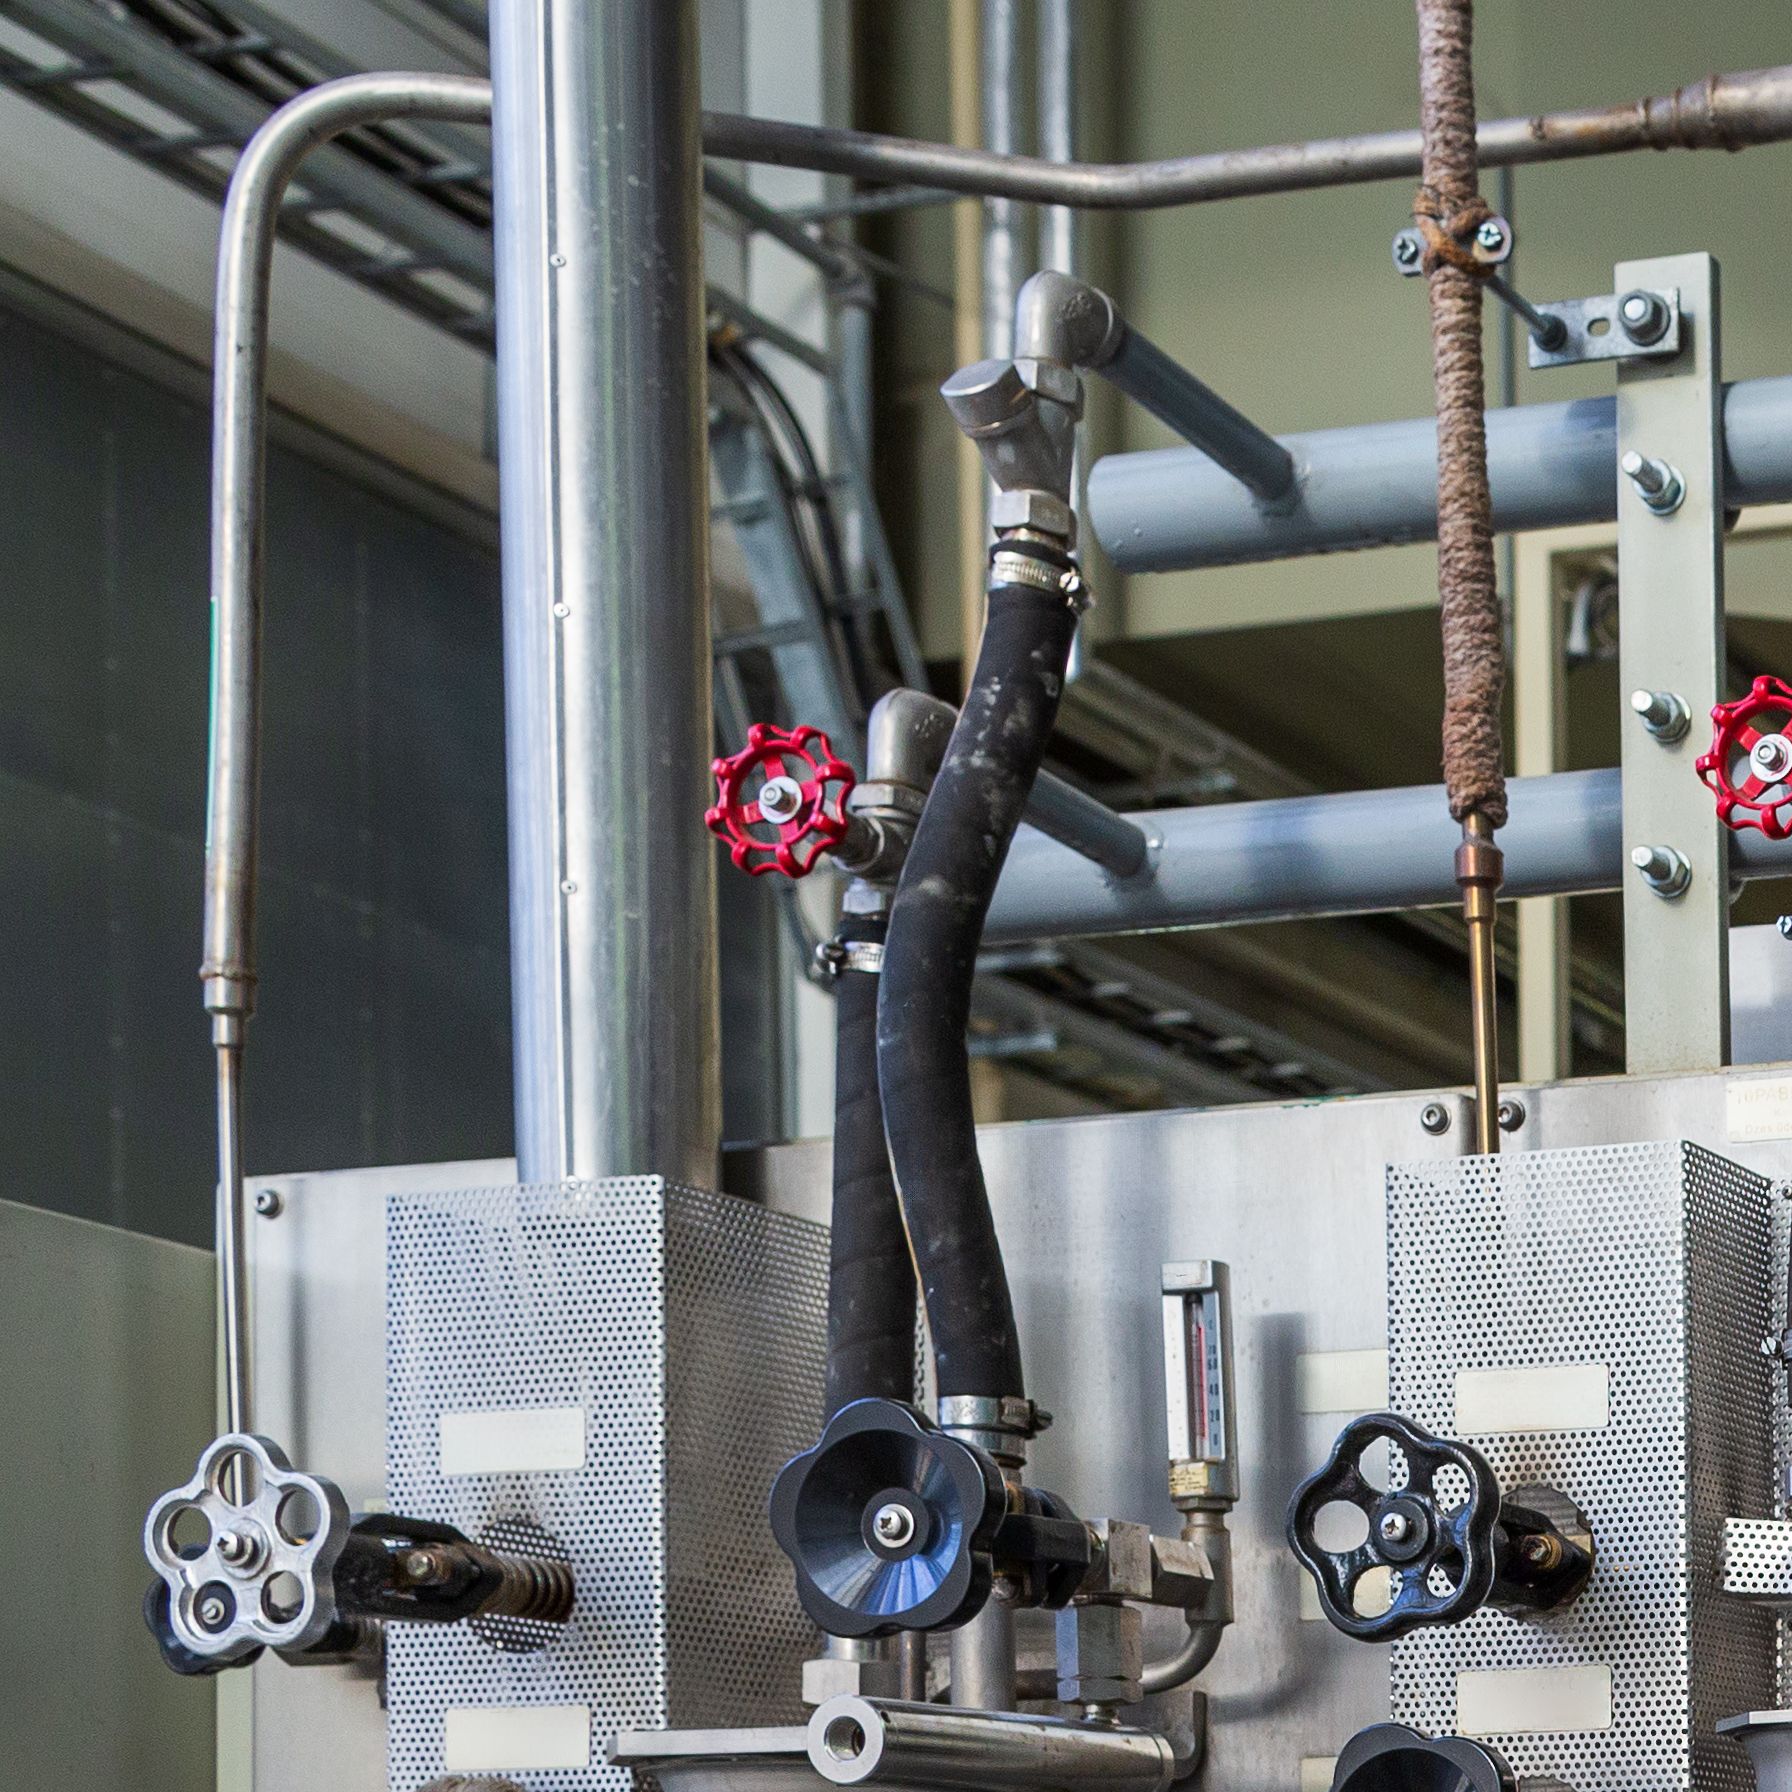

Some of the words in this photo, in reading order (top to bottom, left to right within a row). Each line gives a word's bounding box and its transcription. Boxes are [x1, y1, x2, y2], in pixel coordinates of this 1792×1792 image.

[1208, 1358, 1217, 1370] 60
[1209, 1384, 1219, 1396] 40
[1210, 1410, 1220, 1422] 20
